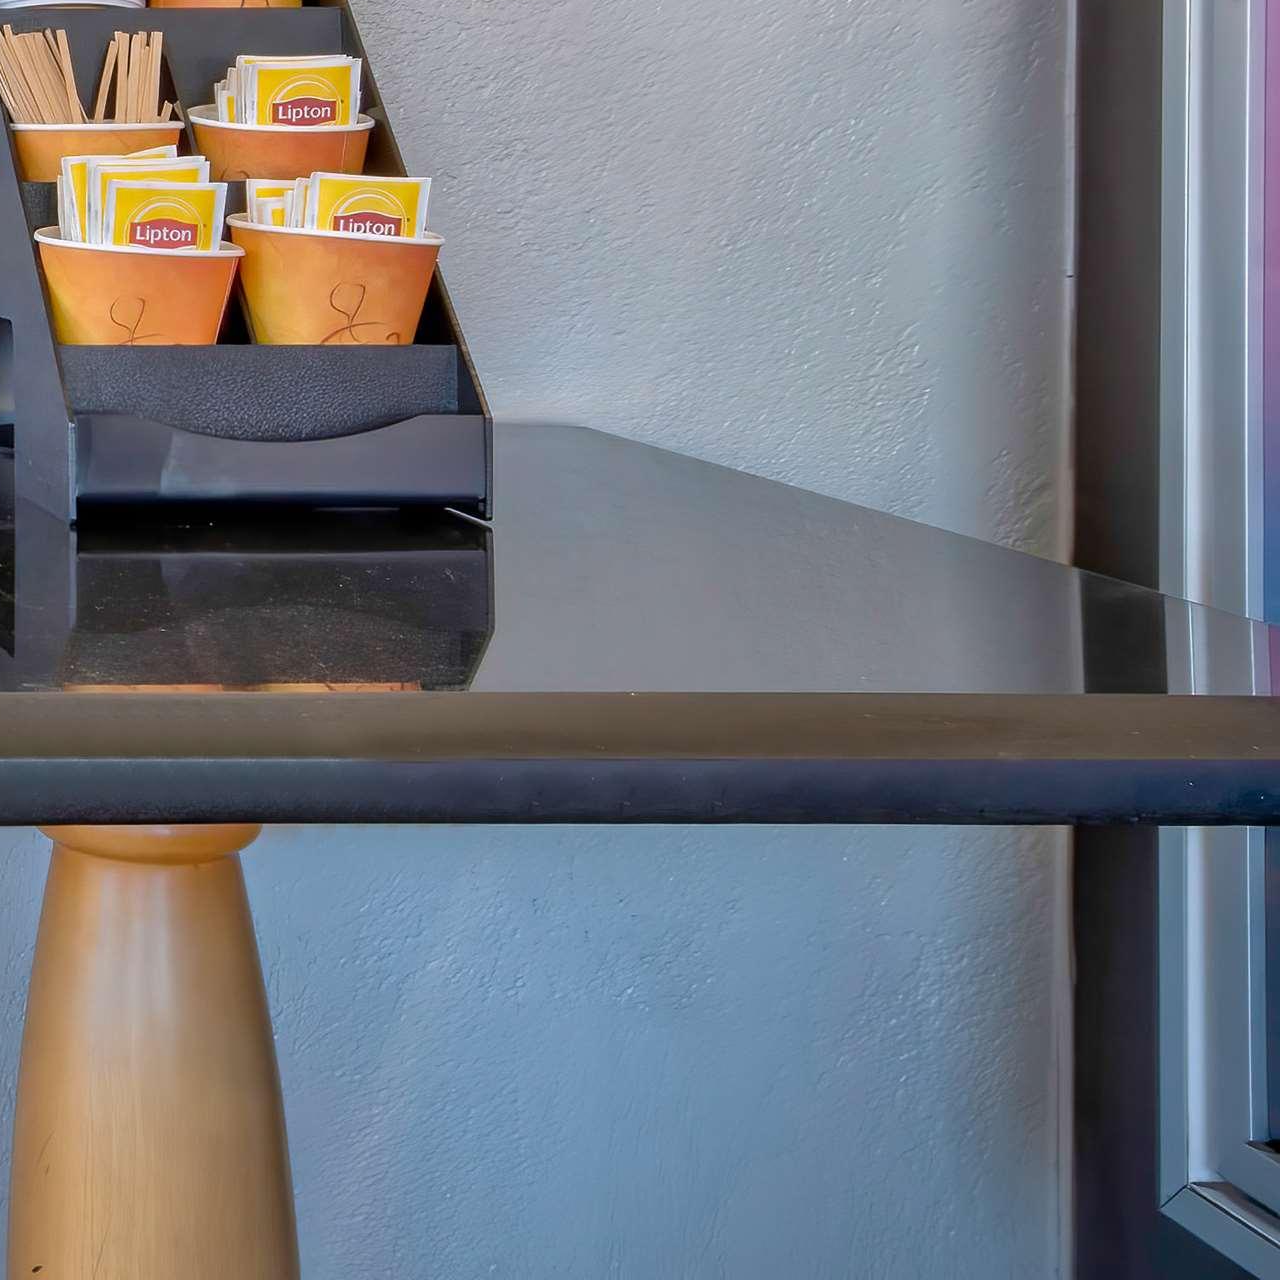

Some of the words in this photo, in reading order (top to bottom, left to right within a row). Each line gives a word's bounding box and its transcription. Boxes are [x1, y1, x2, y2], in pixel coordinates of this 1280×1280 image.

[277, 104, 331, 122] Lipton
[134, 225, 193, 244] Lipton
[339, 218, 397, 236] Lipton
